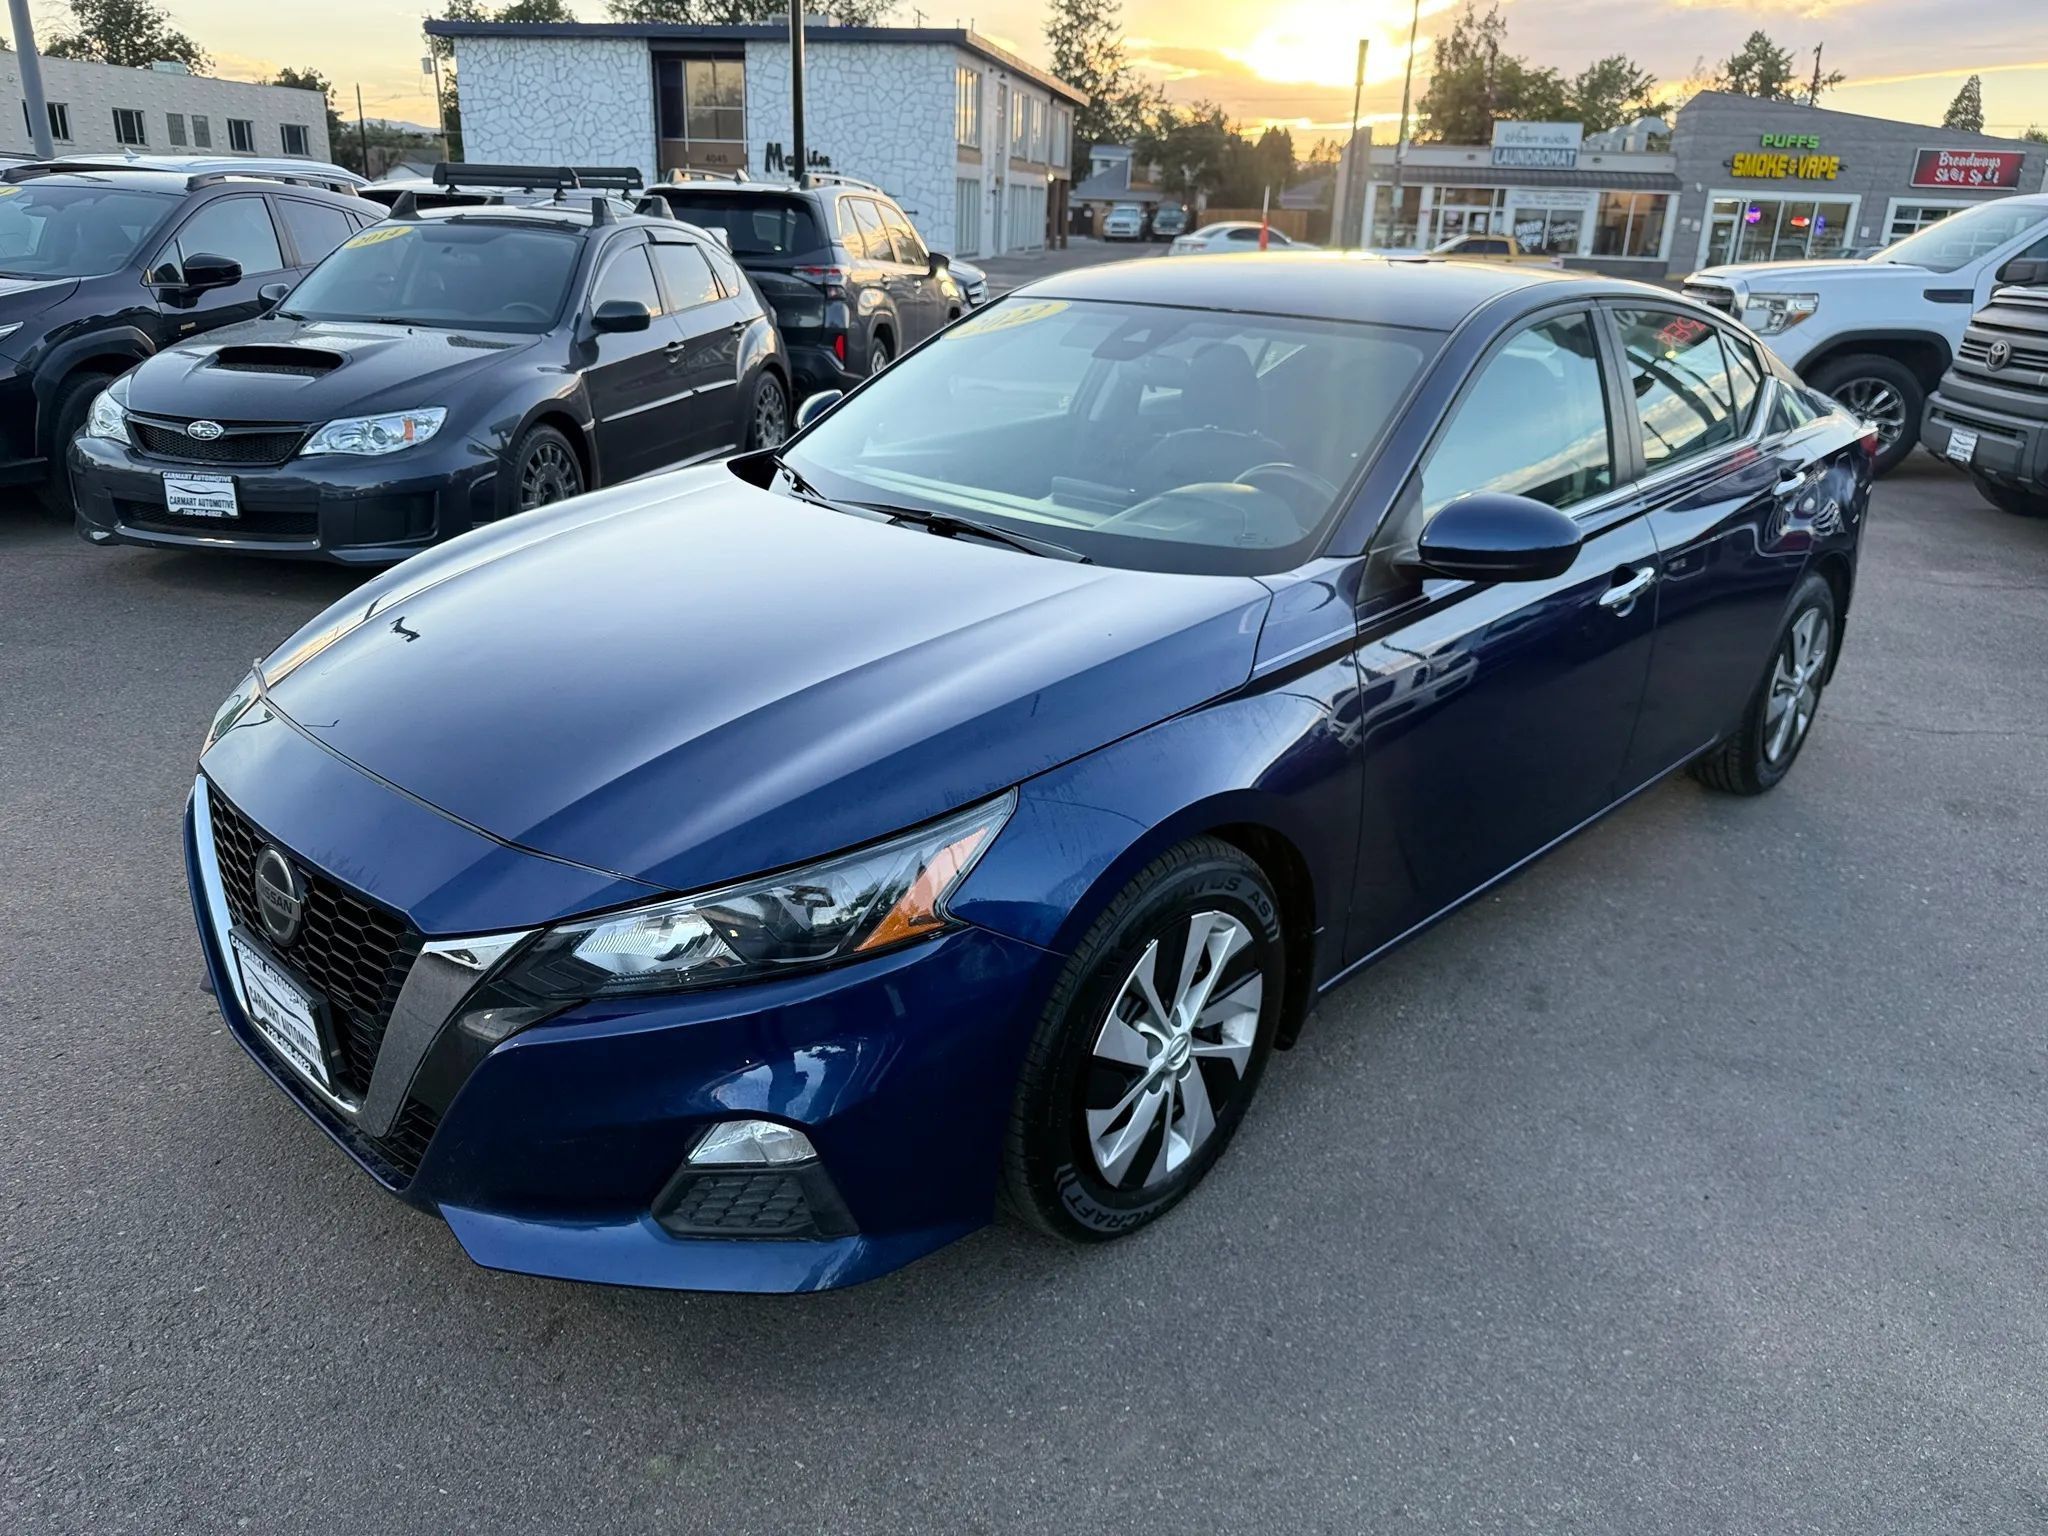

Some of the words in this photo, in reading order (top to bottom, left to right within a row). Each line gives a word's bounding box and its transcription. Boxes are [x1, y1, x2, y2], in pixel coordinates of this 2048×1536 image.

[1761, 134, 1820, 149] PUFFS
[1494, 148, 1575, 167] LAUNDROMAT
[163, 472, 192, 481] CARMART
[193, 474, 232, 483] AUTOMOTIVE
[170, 496, 197, 506] CARMART
[198, 498, 234, 509] AUTOMOTIVE
[249, 985, 280, 1026] CARMART
